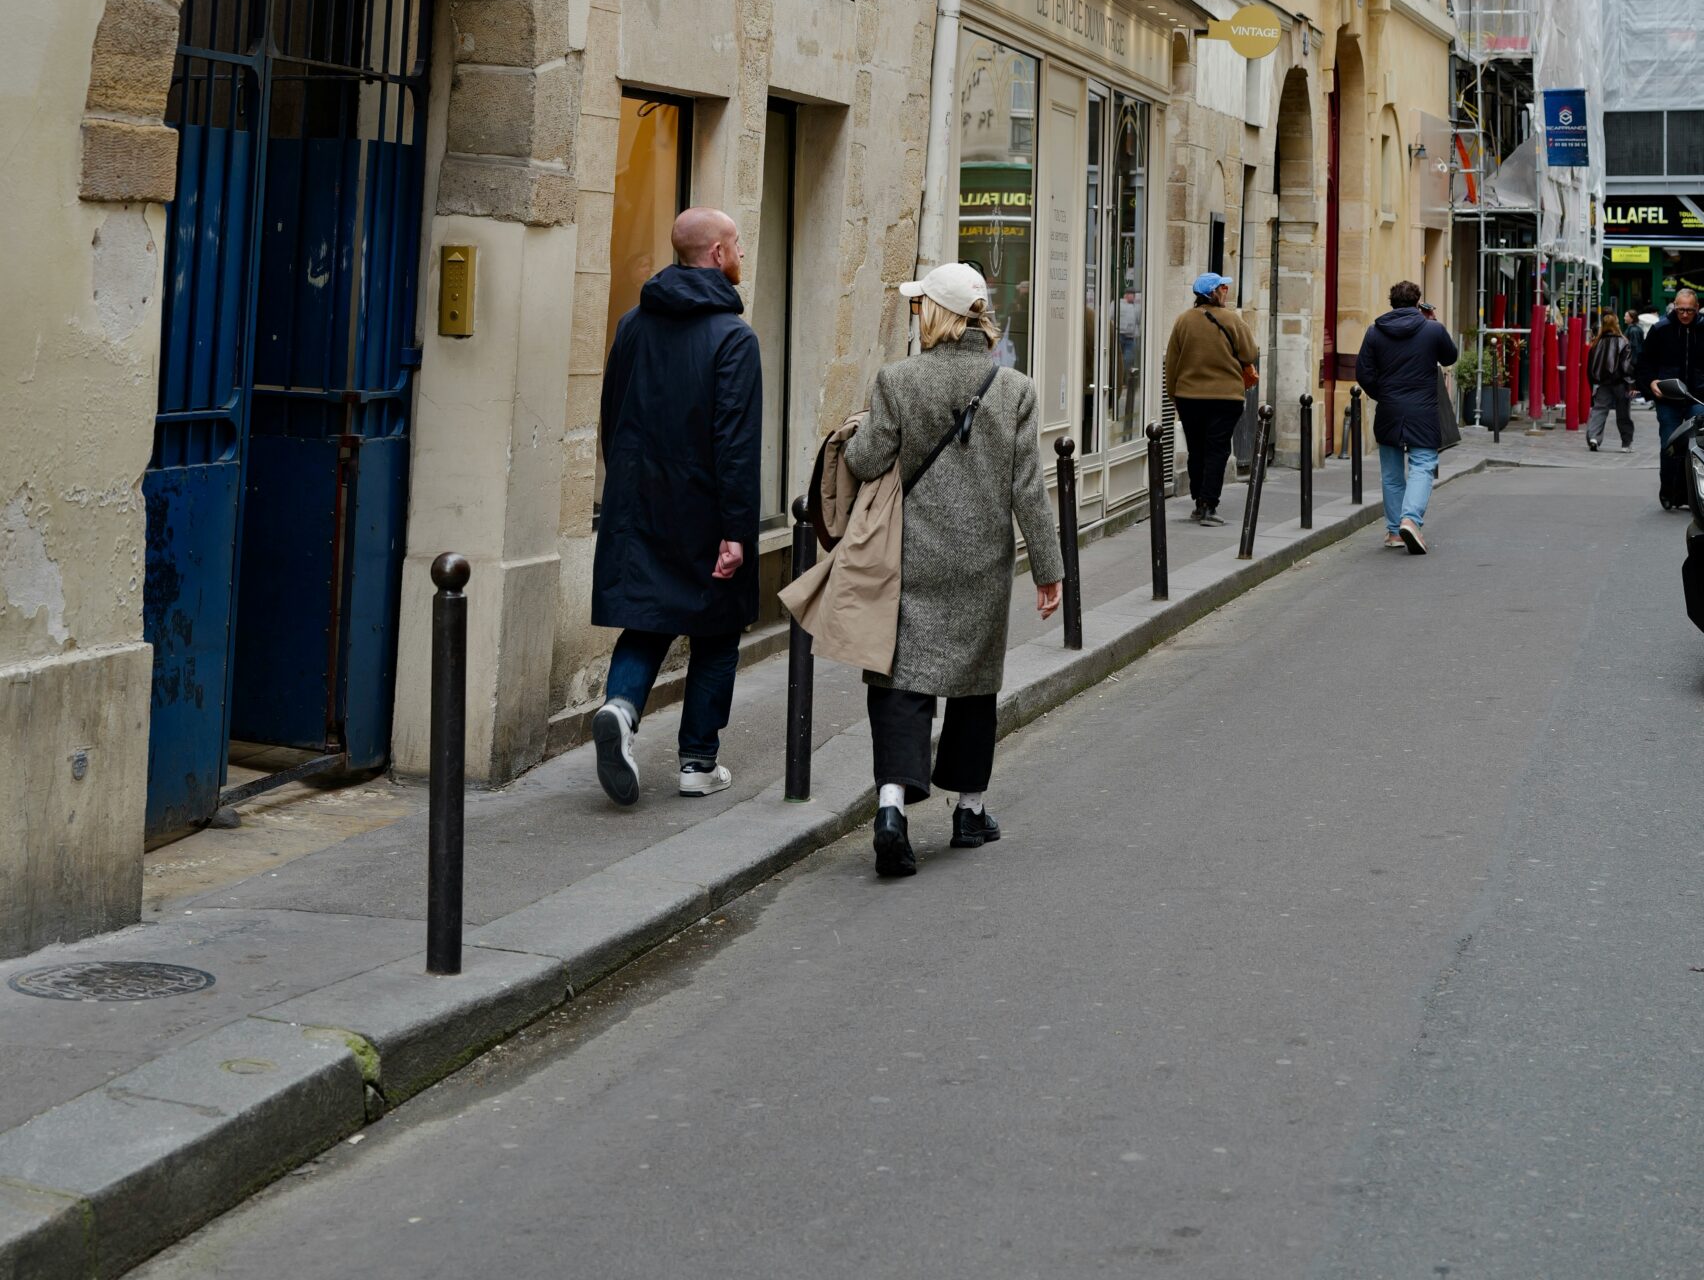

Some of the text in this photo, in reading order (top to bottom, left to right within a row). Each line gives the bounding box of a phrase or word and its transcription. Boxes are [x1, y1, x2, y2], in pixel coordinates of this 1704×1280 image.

[1084, 3, 1096, 42] DU
[1094, 7, 1125, 57] VINTAGE
[1231, 24, 1279, 38] VINTAGE
